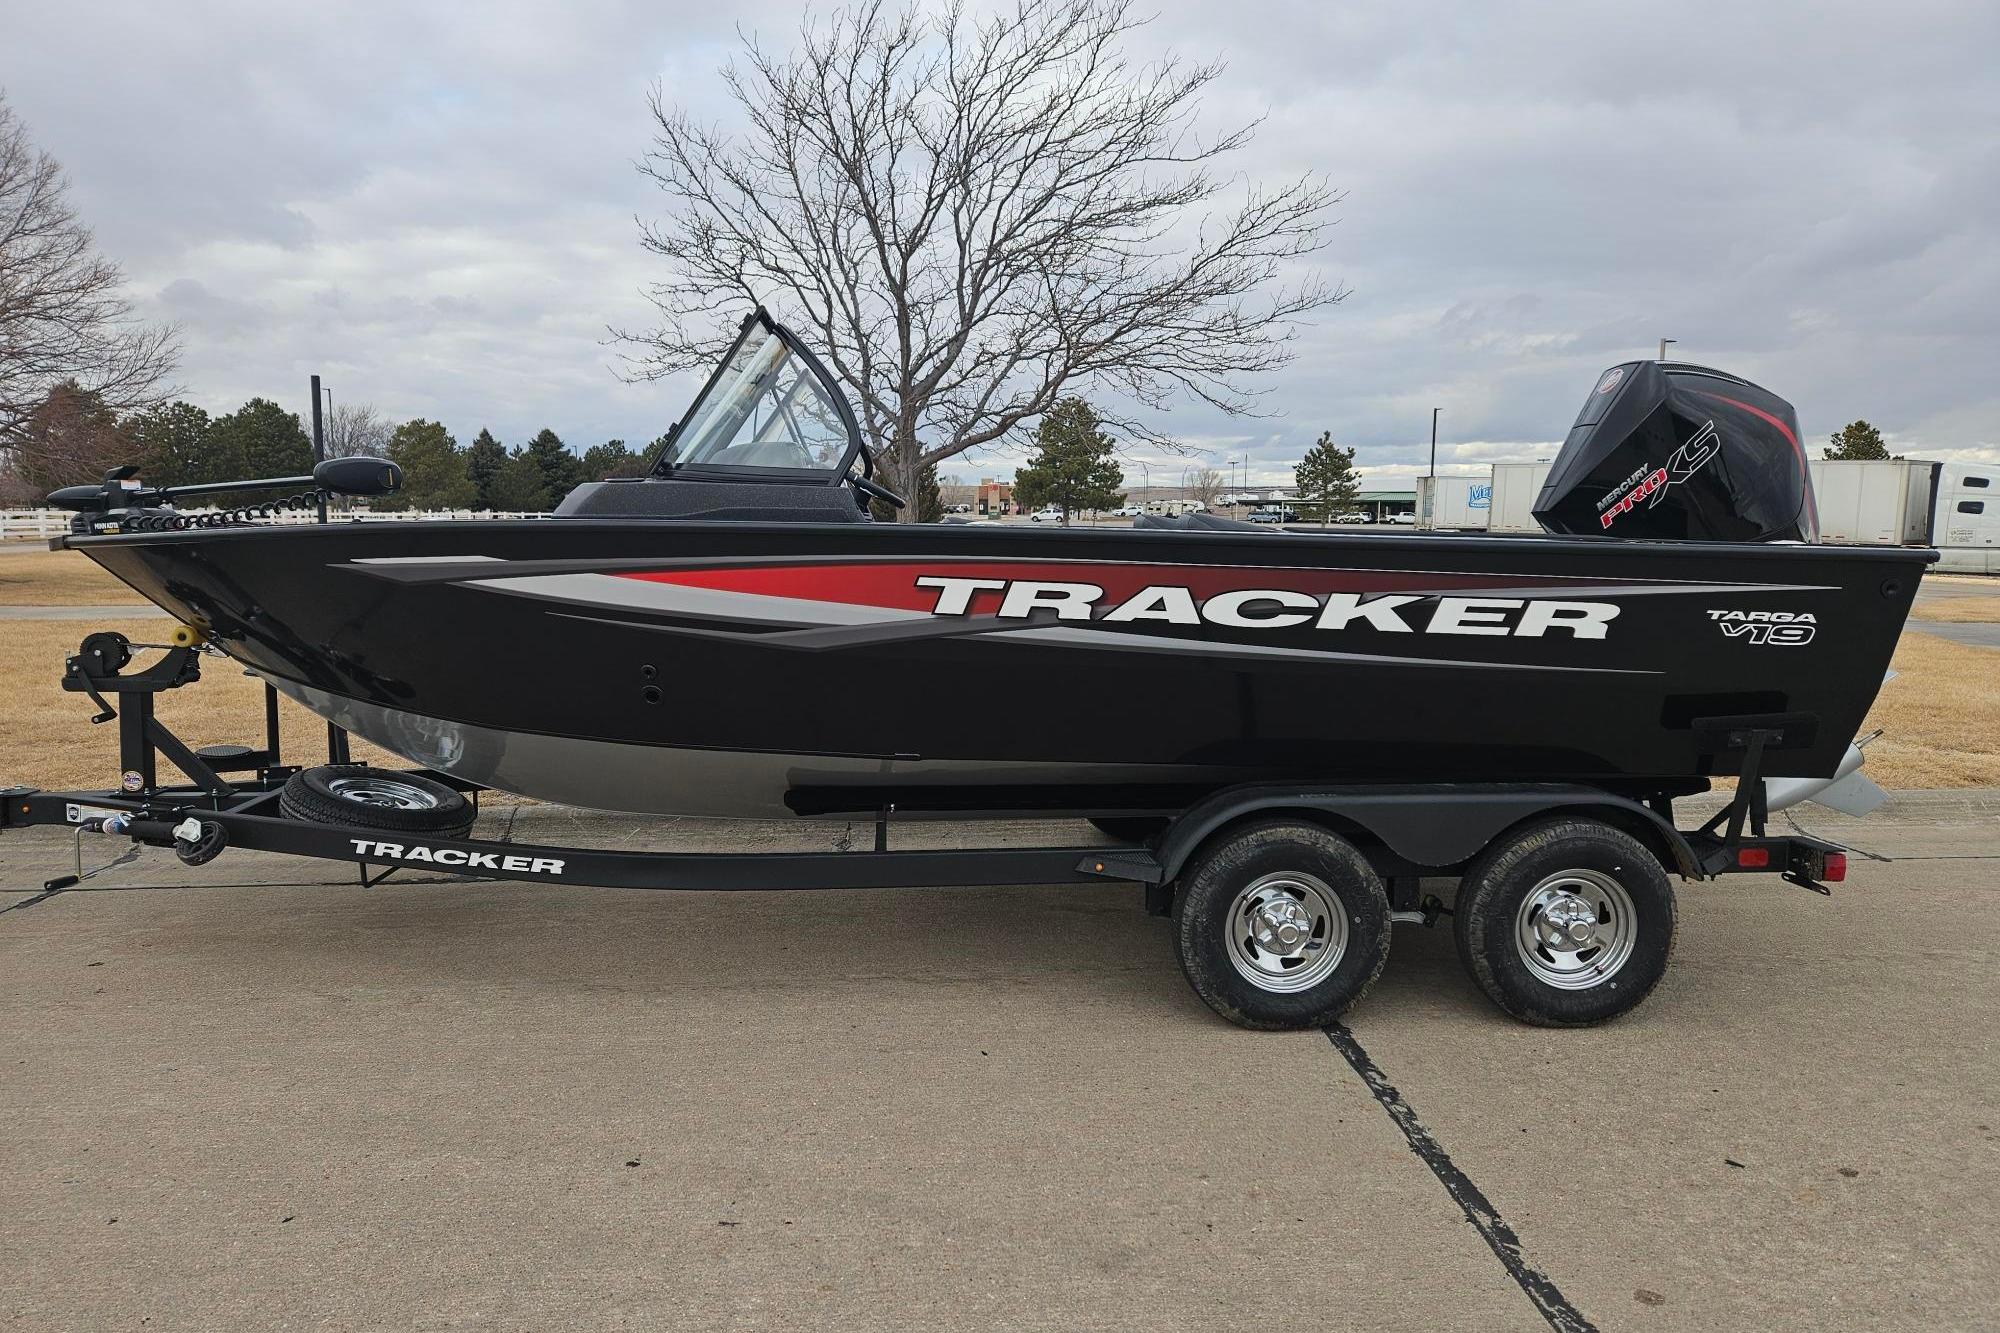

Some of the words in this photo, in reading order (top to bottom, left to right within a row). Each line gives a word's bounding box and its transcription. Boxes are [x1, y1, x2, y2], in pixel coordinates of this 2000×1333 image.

[1596, 462, 1649, 511] MERCURY
[1600, 467, 1668, 529] PRO
[915, 575, 1621, 640] TRACKER
[1706, 609, 1817, 624] TARGA
[1719, 622, 1816, 646] V19
[350, 839, 566, 875] TRACKER
